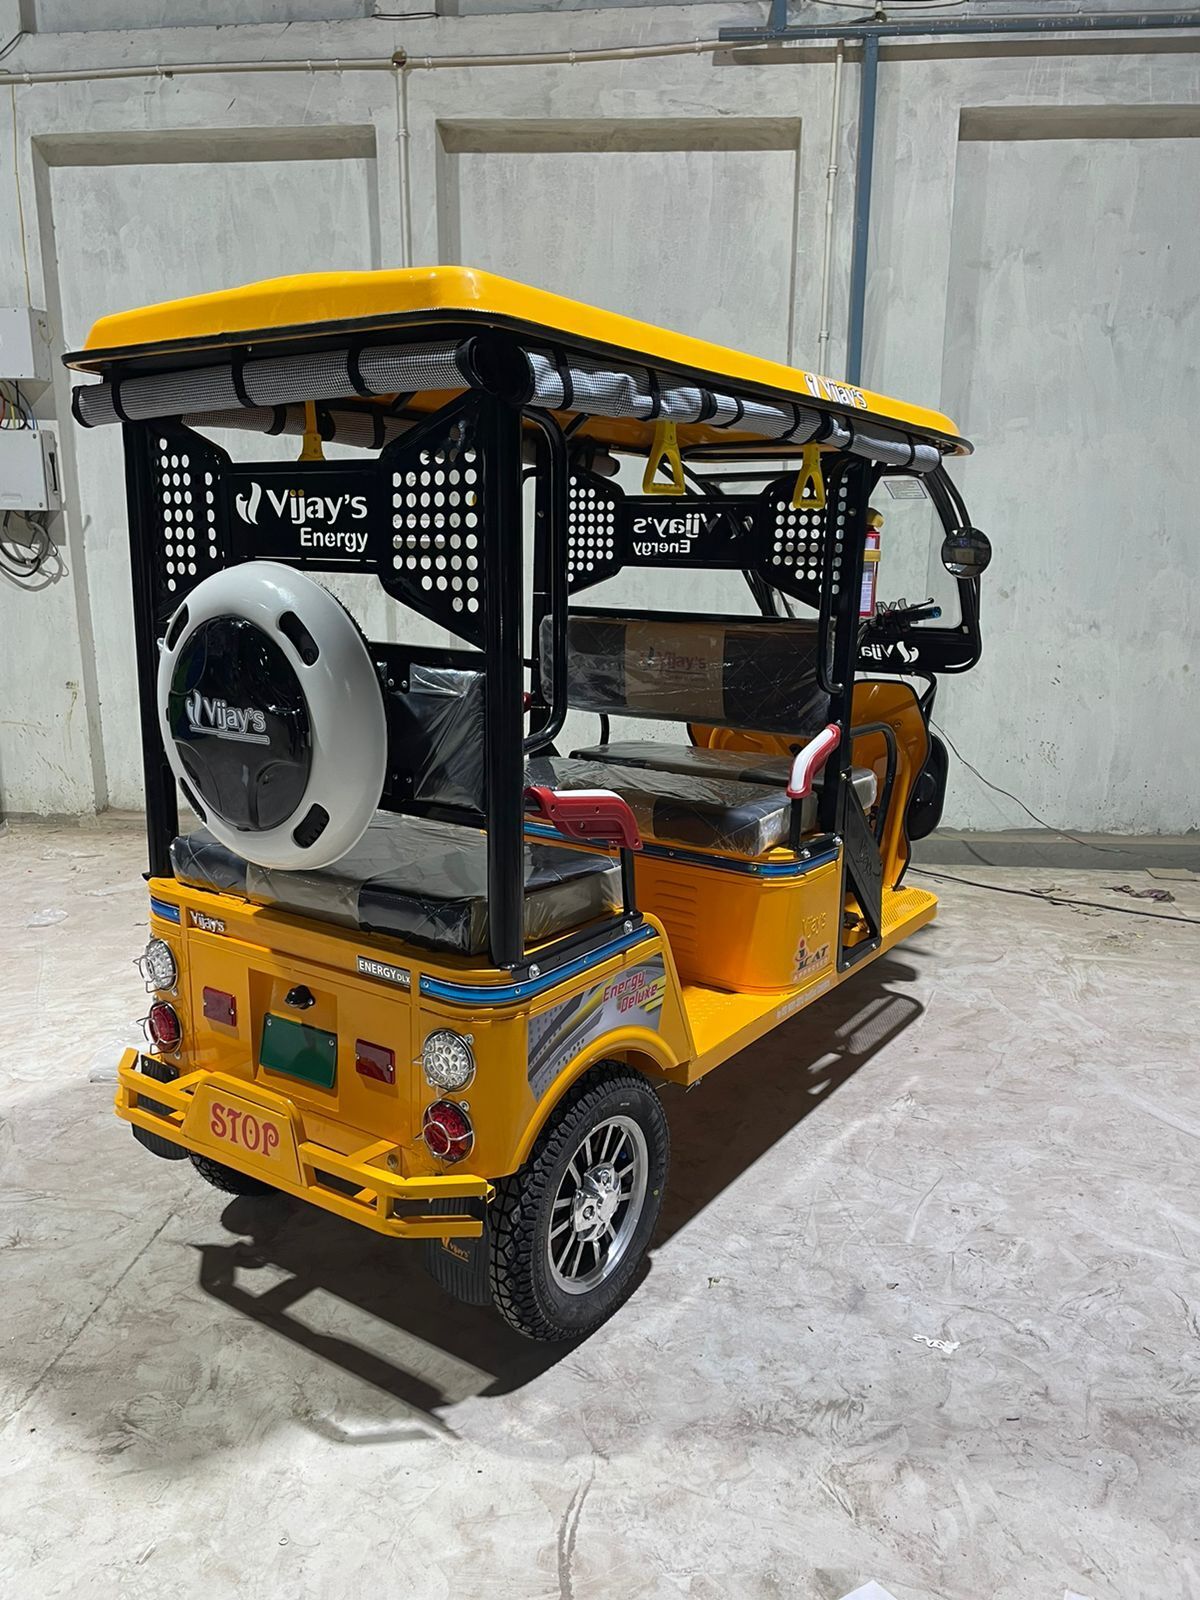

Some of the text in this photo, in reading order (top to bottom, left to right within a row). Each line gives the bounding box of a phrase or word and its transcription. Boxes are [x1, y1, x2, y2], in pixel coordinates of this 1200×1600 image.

[265, 488, 368, 525] Vijay's
[300, 527, 369, 553] Energy
[202, 697, 266, 734] Vijay's
[359, 959, 397, 980] ENERGY
[602, 970, 647, 1003] Energy
[620, 983, 659, 1014] Deluxe
[210, 1102, 280, 1158] STOP
